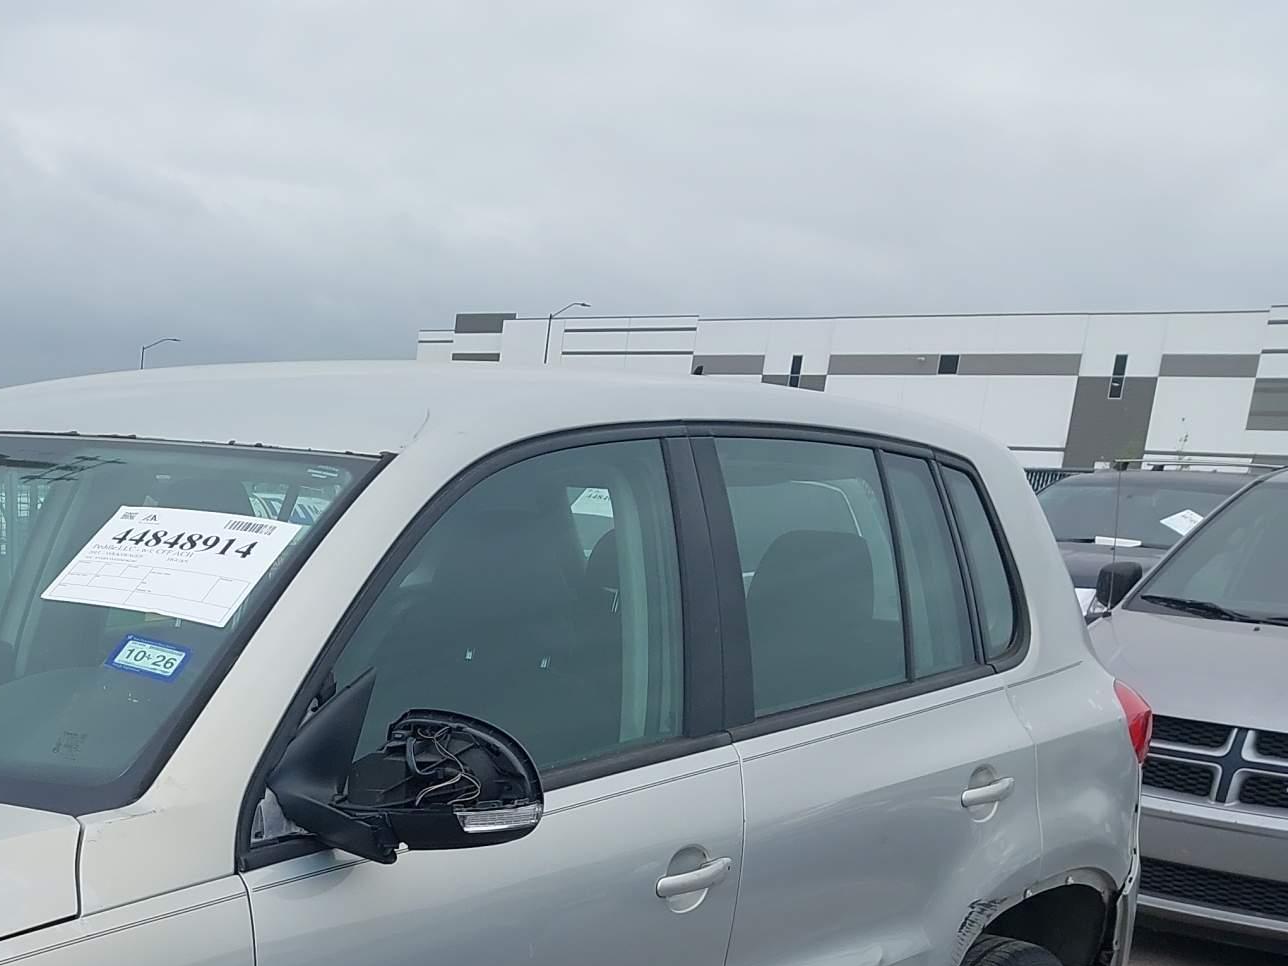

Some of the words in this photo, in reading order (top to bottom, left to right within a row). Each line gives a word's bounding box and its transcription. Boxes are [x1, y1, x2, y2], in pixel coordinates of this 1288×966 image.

[111, 527, 259, 559] 44848914
[125, 648, 147, 662] 10
[152, 654, 177, 669] 26
